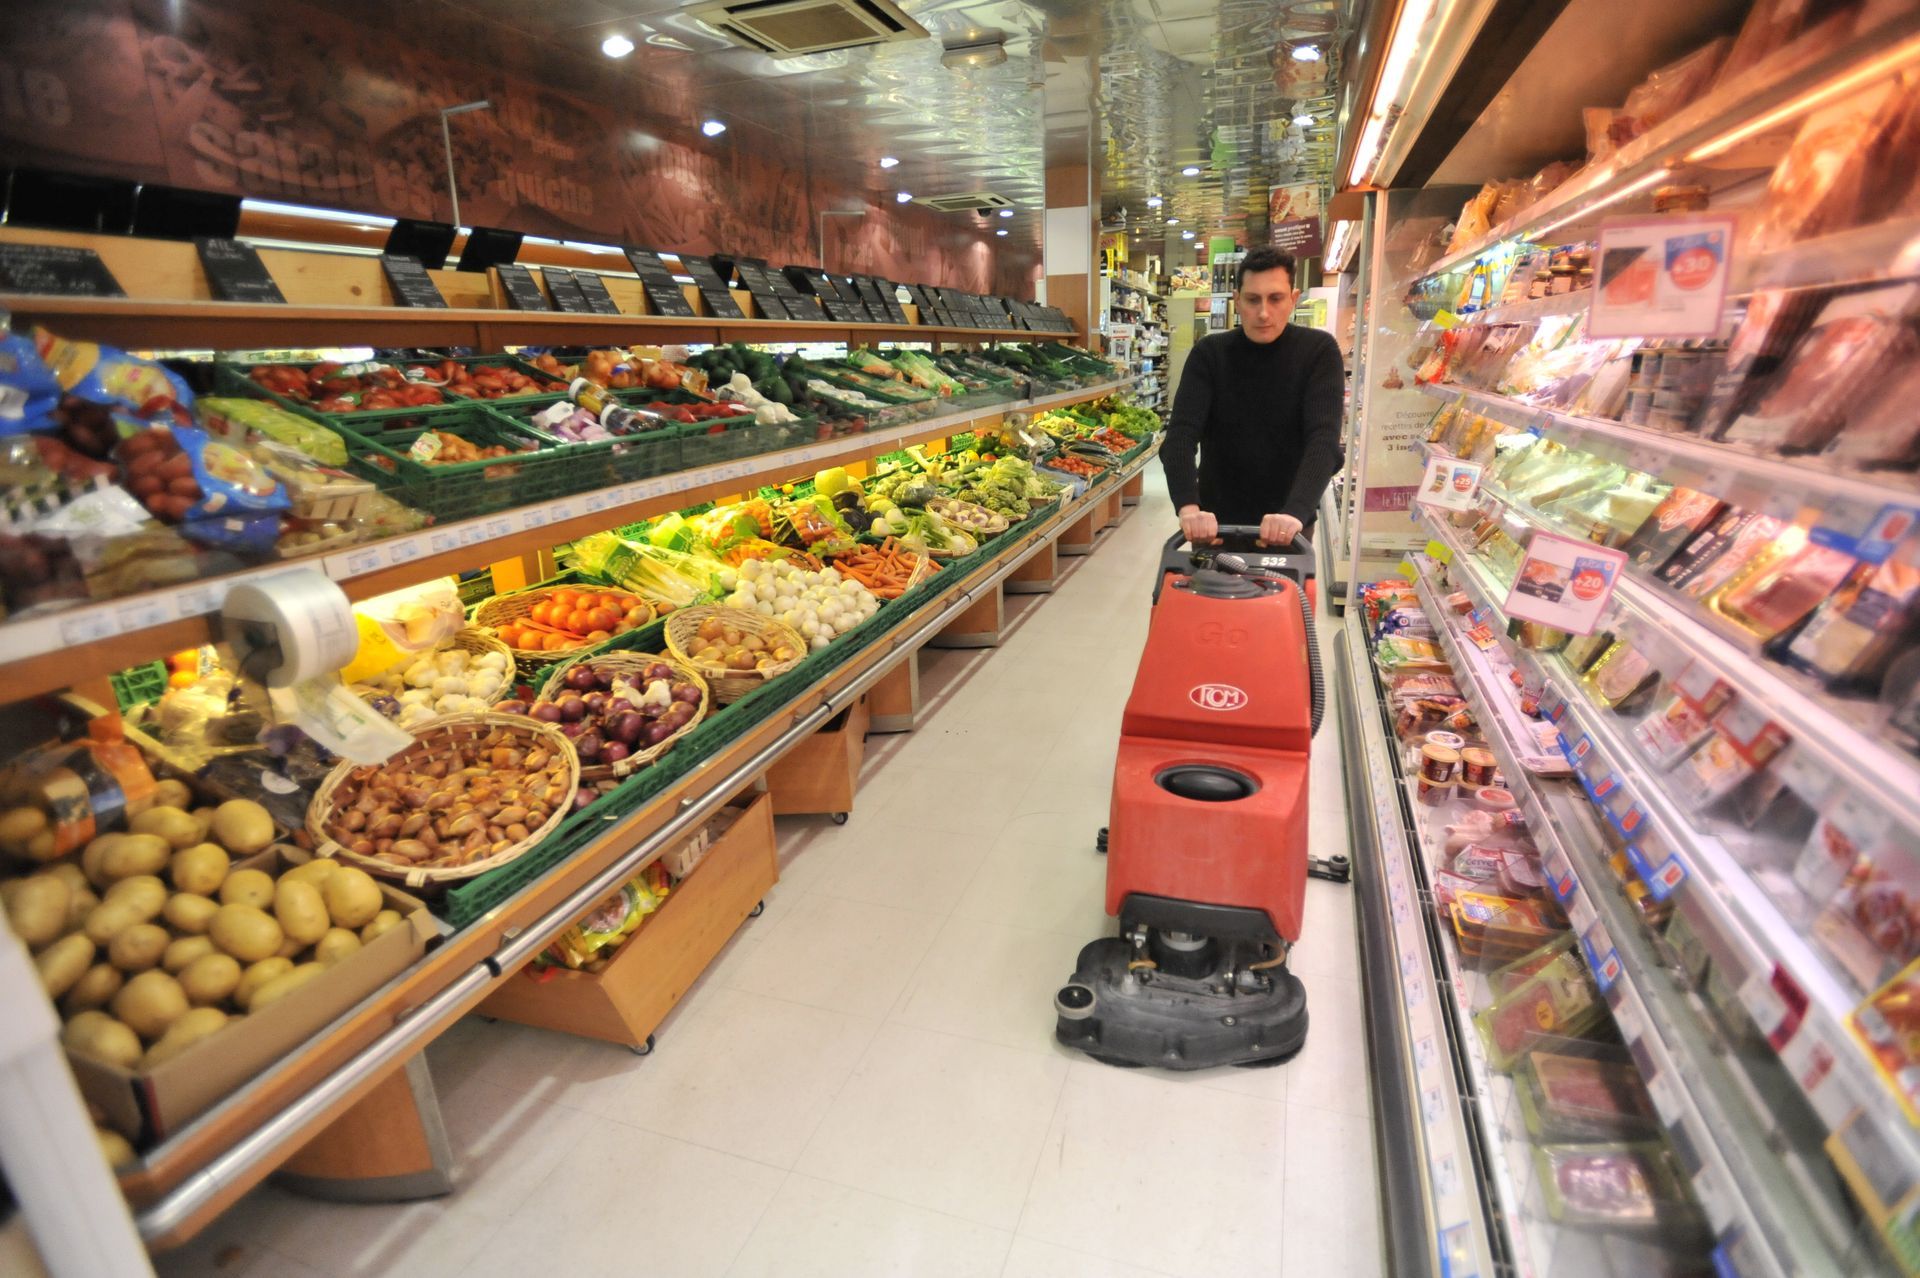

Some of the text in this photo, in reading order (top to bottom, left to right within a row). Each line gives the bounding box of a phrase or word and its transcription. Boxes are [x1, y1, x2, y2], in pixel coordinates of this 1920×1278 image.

[1395, 411, 1435, 420] Découvre
[1387, 444, 1394, 452] 3
[1260, 556, 1287, 567] 532
[1574, 576, 1601, 589] +20
